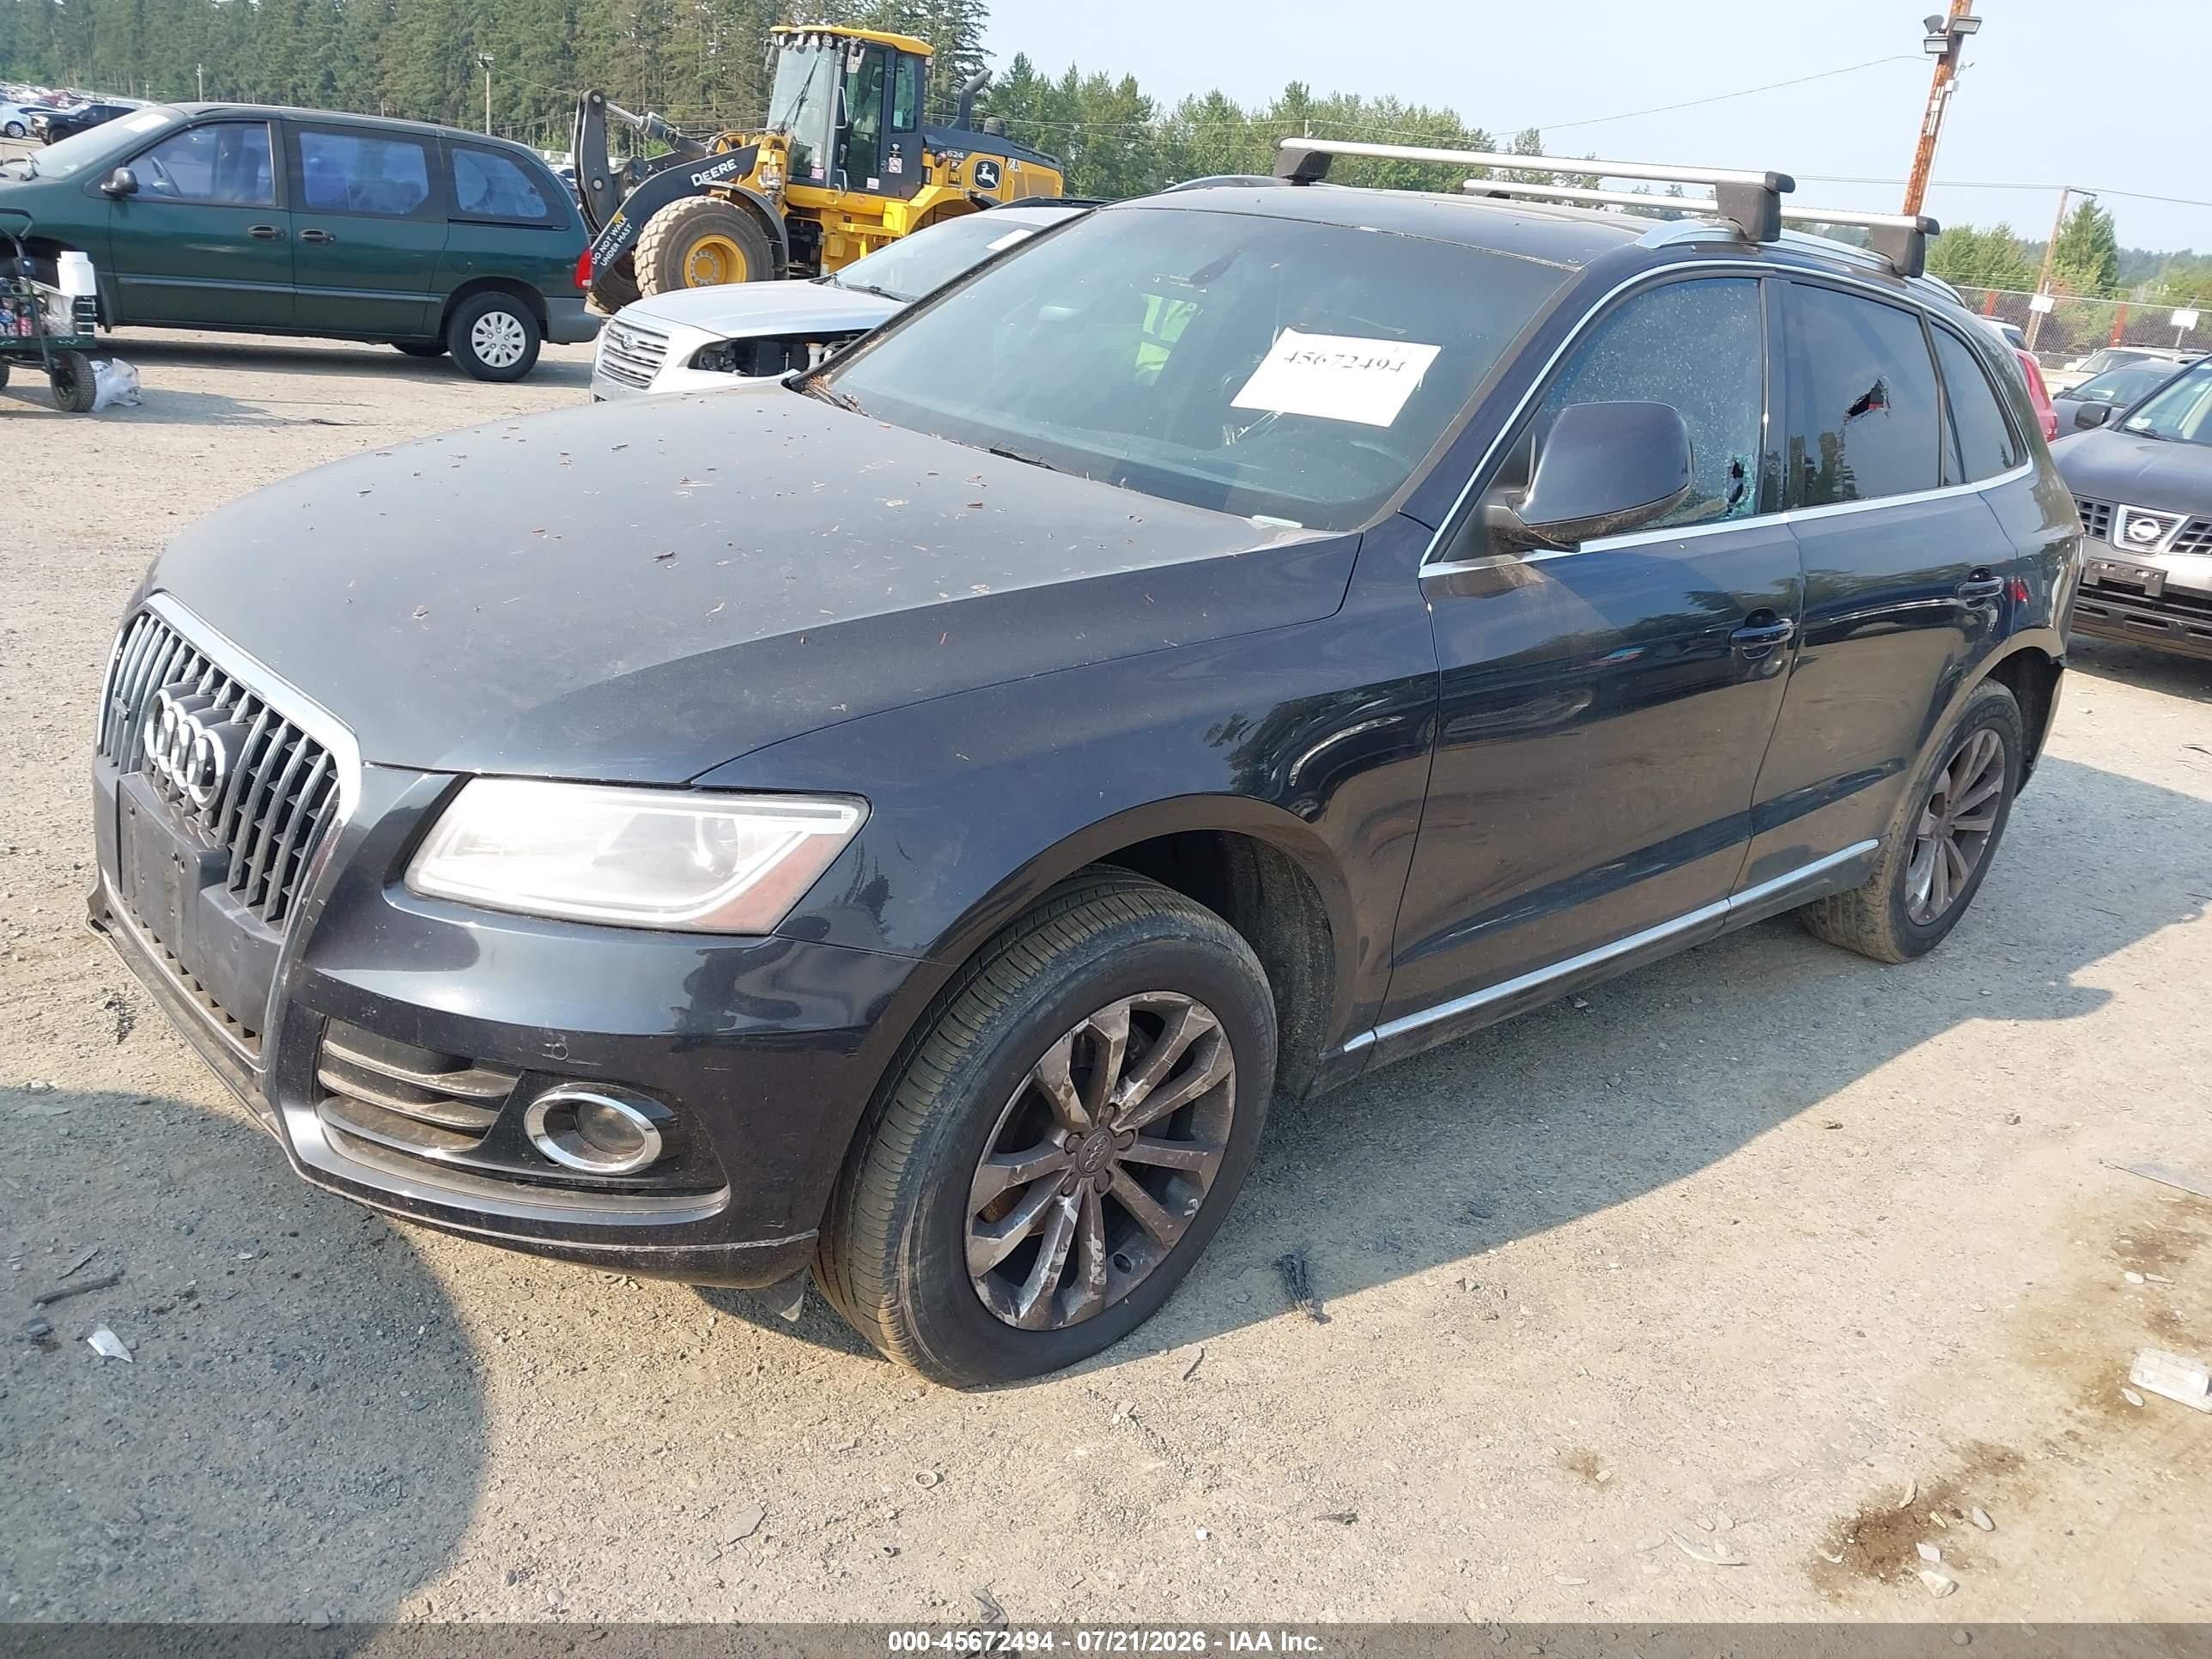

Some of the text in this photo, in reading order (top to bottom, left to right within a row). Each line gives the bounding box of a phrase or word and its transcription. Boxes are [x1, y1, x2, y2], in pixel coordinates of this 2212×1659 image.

[946, 149, 963, 159] 624
[690, 158, 738, 186] DEERE
[591, 217, 629, 264] DO NOT WALK
[599, 223, 633, 266] UNDER MAST
[1285, 351, 1406, 372] 45672494
